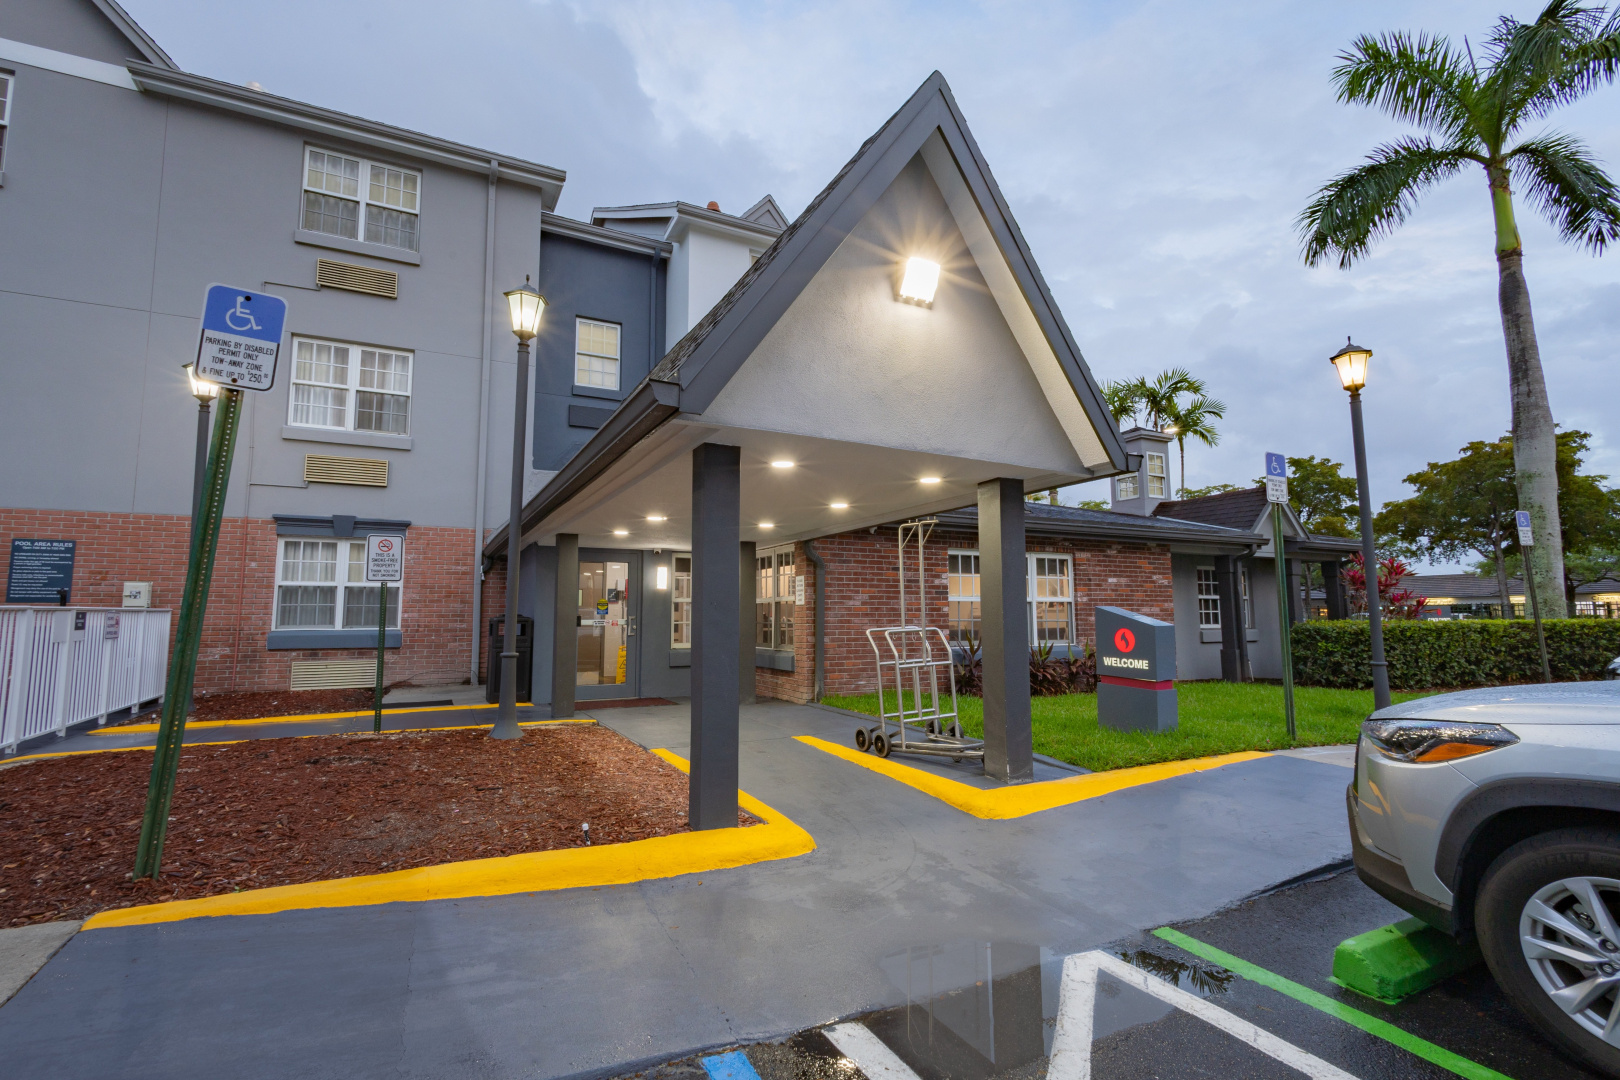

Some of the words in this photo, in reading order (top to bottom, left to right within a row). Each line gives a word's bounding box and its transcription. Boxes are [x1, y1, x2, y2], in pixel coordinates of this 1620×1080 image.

[205, 336, 232, 347] PARKING
[244, 344, 274, 356] DISABLED
[218, 348, 241, 358] PERMIT
[244, 352, 259, 360] ONLY
[212, 356, 244, 368] TOW-AWAY
[246, 362, 263, 372] ZONE
[210, 368, 224, 376] FINE
[1103, 656, 1149, 670] WELCOME
